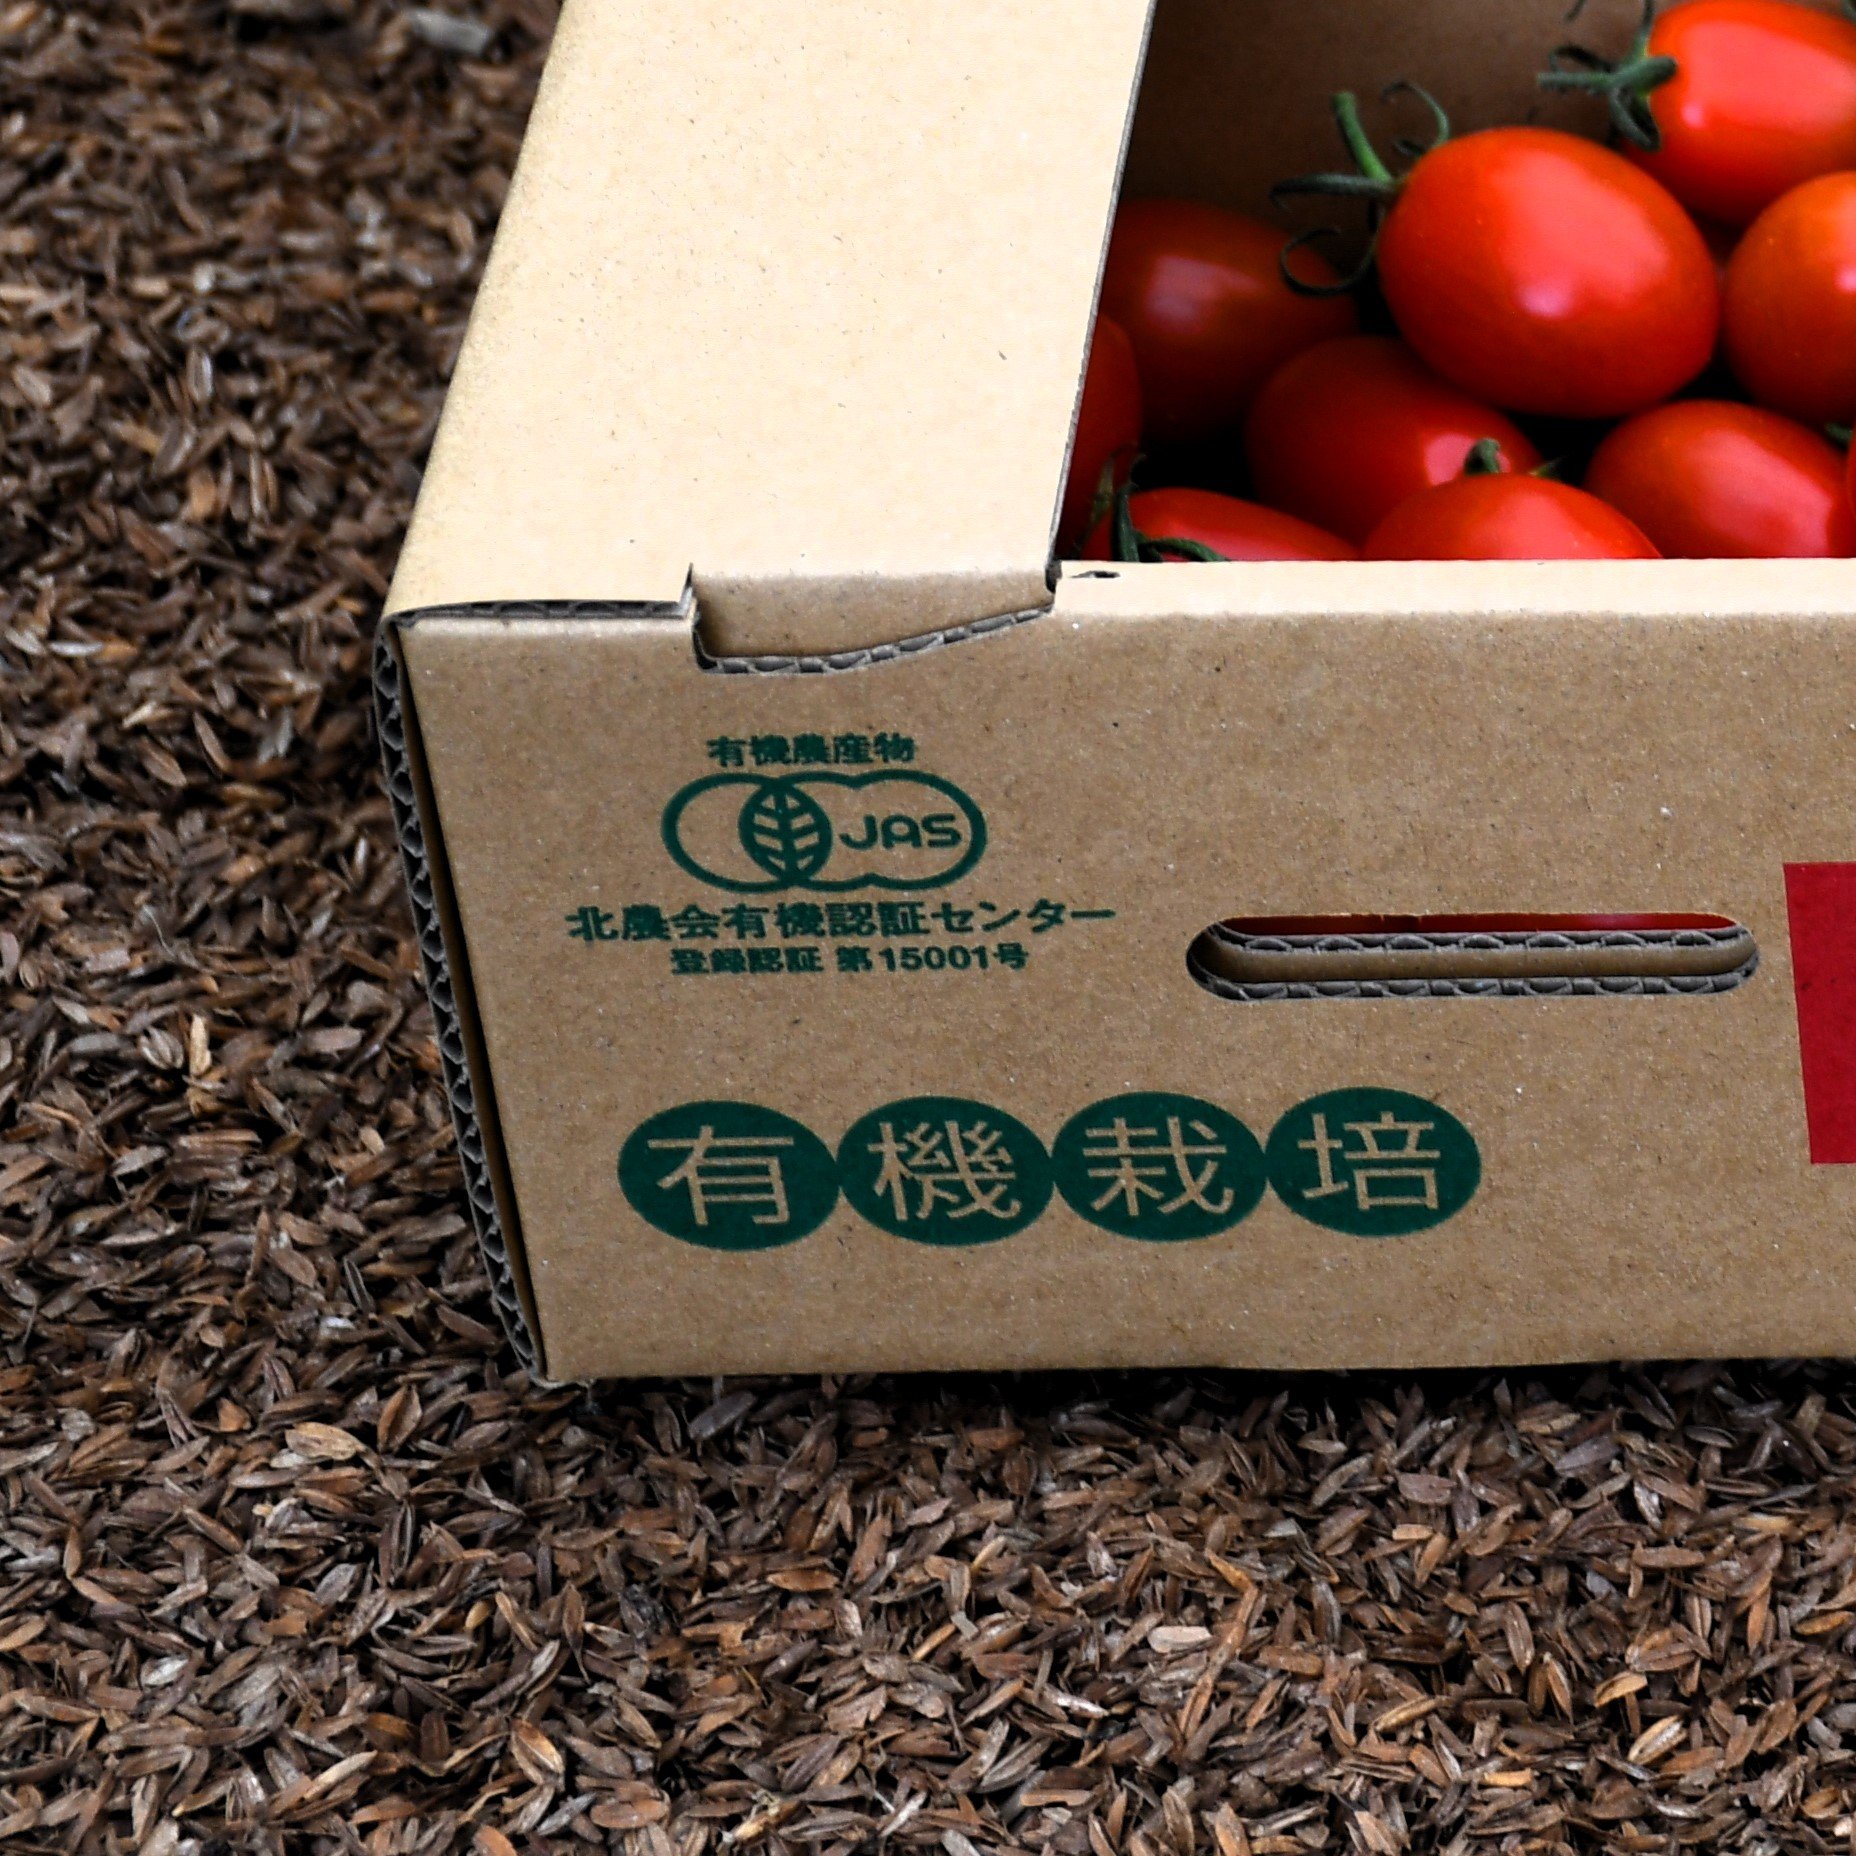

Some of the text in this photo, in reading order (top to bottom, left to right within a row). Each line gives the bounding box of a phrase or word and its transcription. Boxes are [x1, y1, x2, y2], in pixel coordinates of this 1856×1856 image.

[707, 732, 916, 766] 有機農産物
[839, 813, 961, 849] JAS
[836, 942, 1029, 973] 第15001号
[646, 1112, 1442, 1226] 有機栽培
